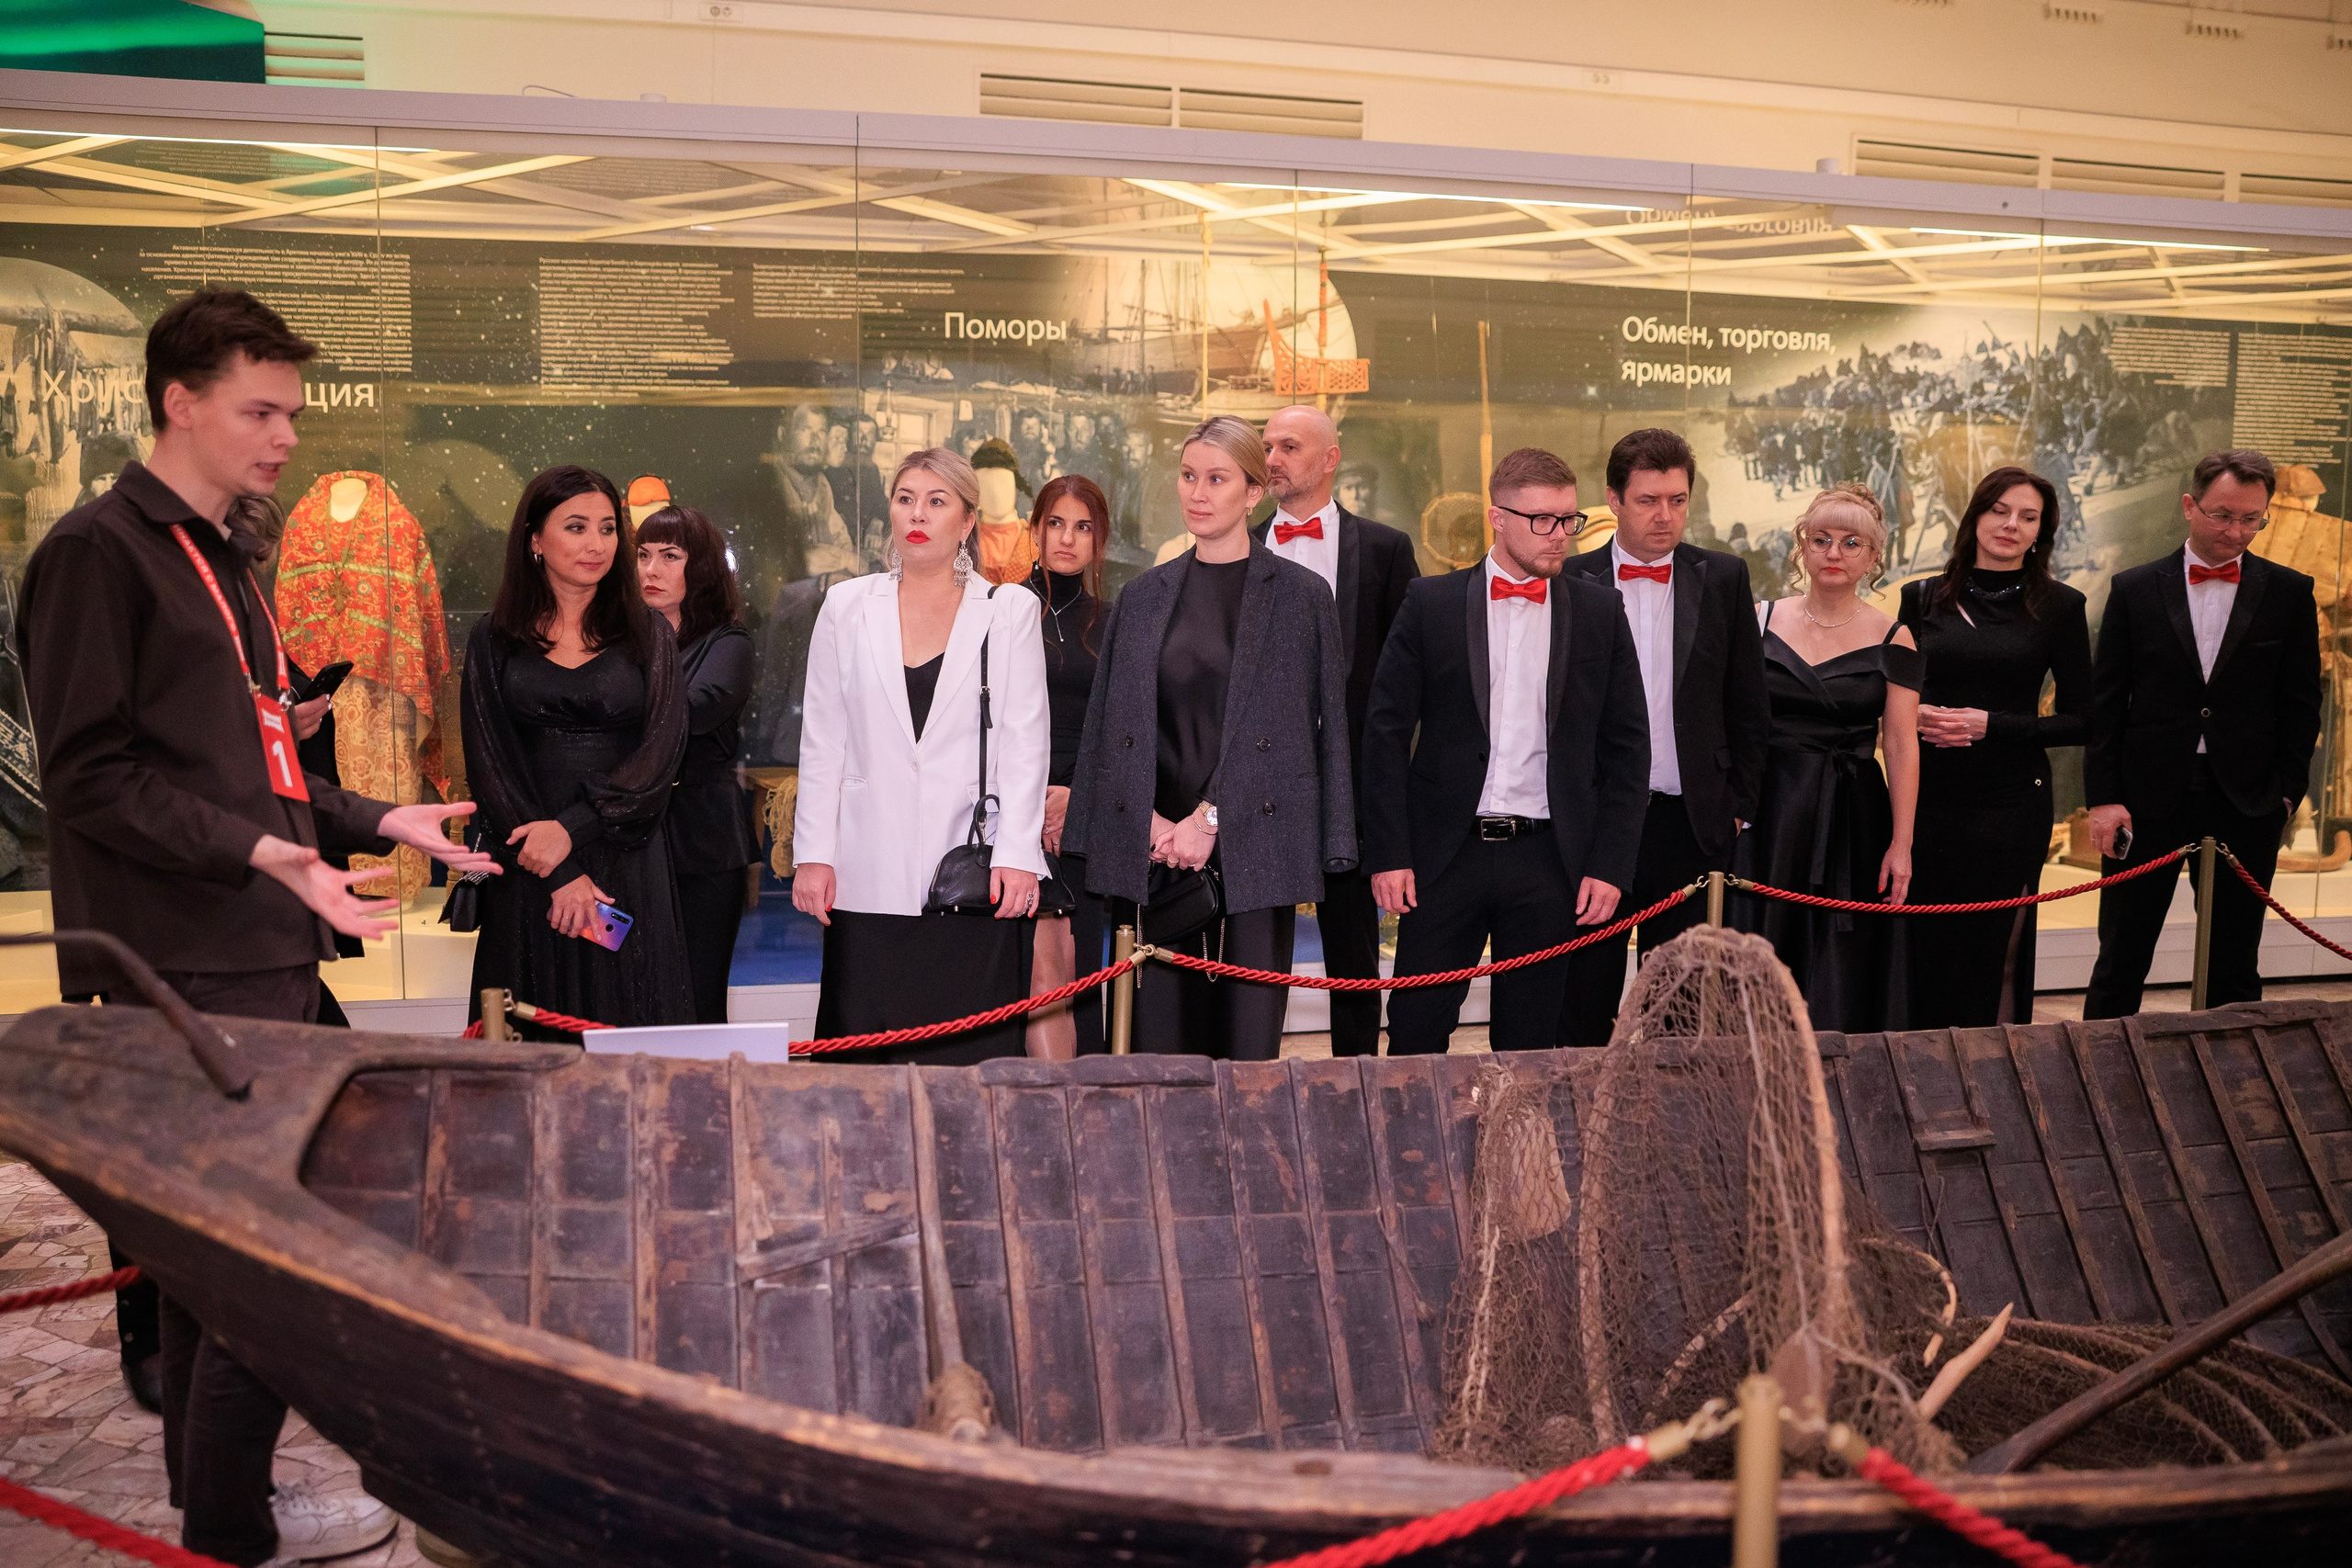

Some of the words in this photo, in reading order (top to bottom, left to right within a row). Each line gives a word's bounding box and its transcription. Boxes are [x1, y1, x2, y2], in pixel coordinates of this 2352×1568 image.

[944, 311, 1067, 347] Поморы
[1622, 315, 1714, 350] Обмен,
[1718, 326, 1837, 355] торговля,
[1621, 361, 1732, 389] ярмарки
[272, 740, 293, 788] 1
